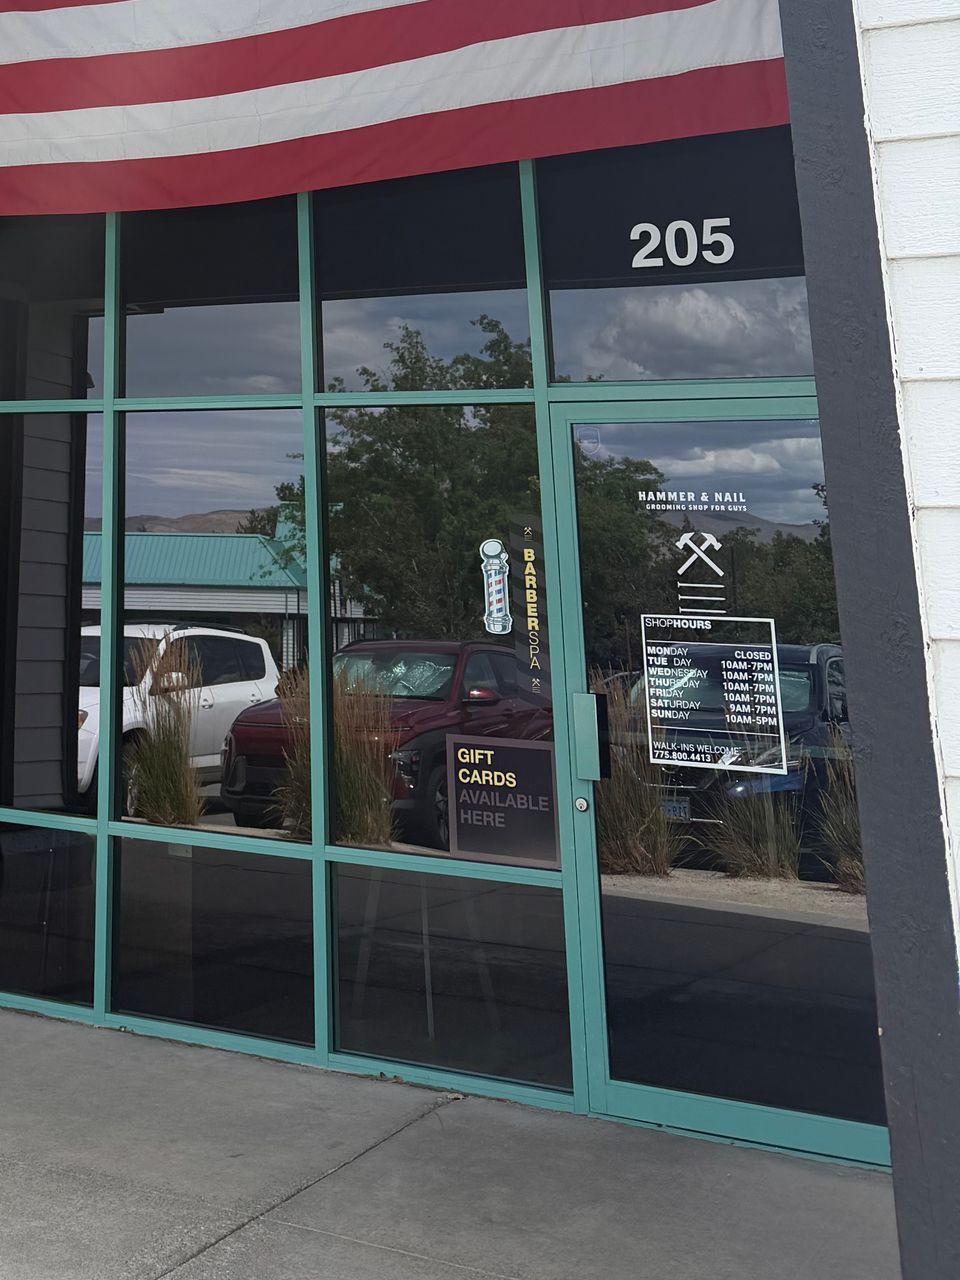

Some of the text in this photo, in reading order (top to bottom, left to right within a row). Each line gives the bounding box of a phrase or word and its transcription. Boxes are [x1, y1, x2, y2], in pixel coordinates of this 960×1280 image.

[629, 217, 735, 268] 205
[638, 491, 747, 502] HAMMER & NAIL
[645, 503, 687, 511] GROOMING
[727, 504, 748, 512] GUYS
[647, 646, 772, 661] MONDAY CLOSED
[647, 656, 773, 671] TUE DAY 10AM-7PM
[648, 667, 774, 682] WEDNESDAY 10AM-7PM
[722, 682, 775, 693] 10AM-7PM
[650, 688, 776, 704] FRIDAY 10AM-7PM
[650, 698, 777, 714] SATURDAY 9AM-7PM
[651, 709, 778, 726] SUNDAY 10AM-5PM
[653, 740, 695, 752] WALK-INS
[457, 748, 495, 765] GIFT
[654, 750, 712, 762] 775.800.4413
[458, 768, 517, 788] CARDS
[459, 789, 550, 812] AVAILABLE
[460, 809, 506, 828] HERE
